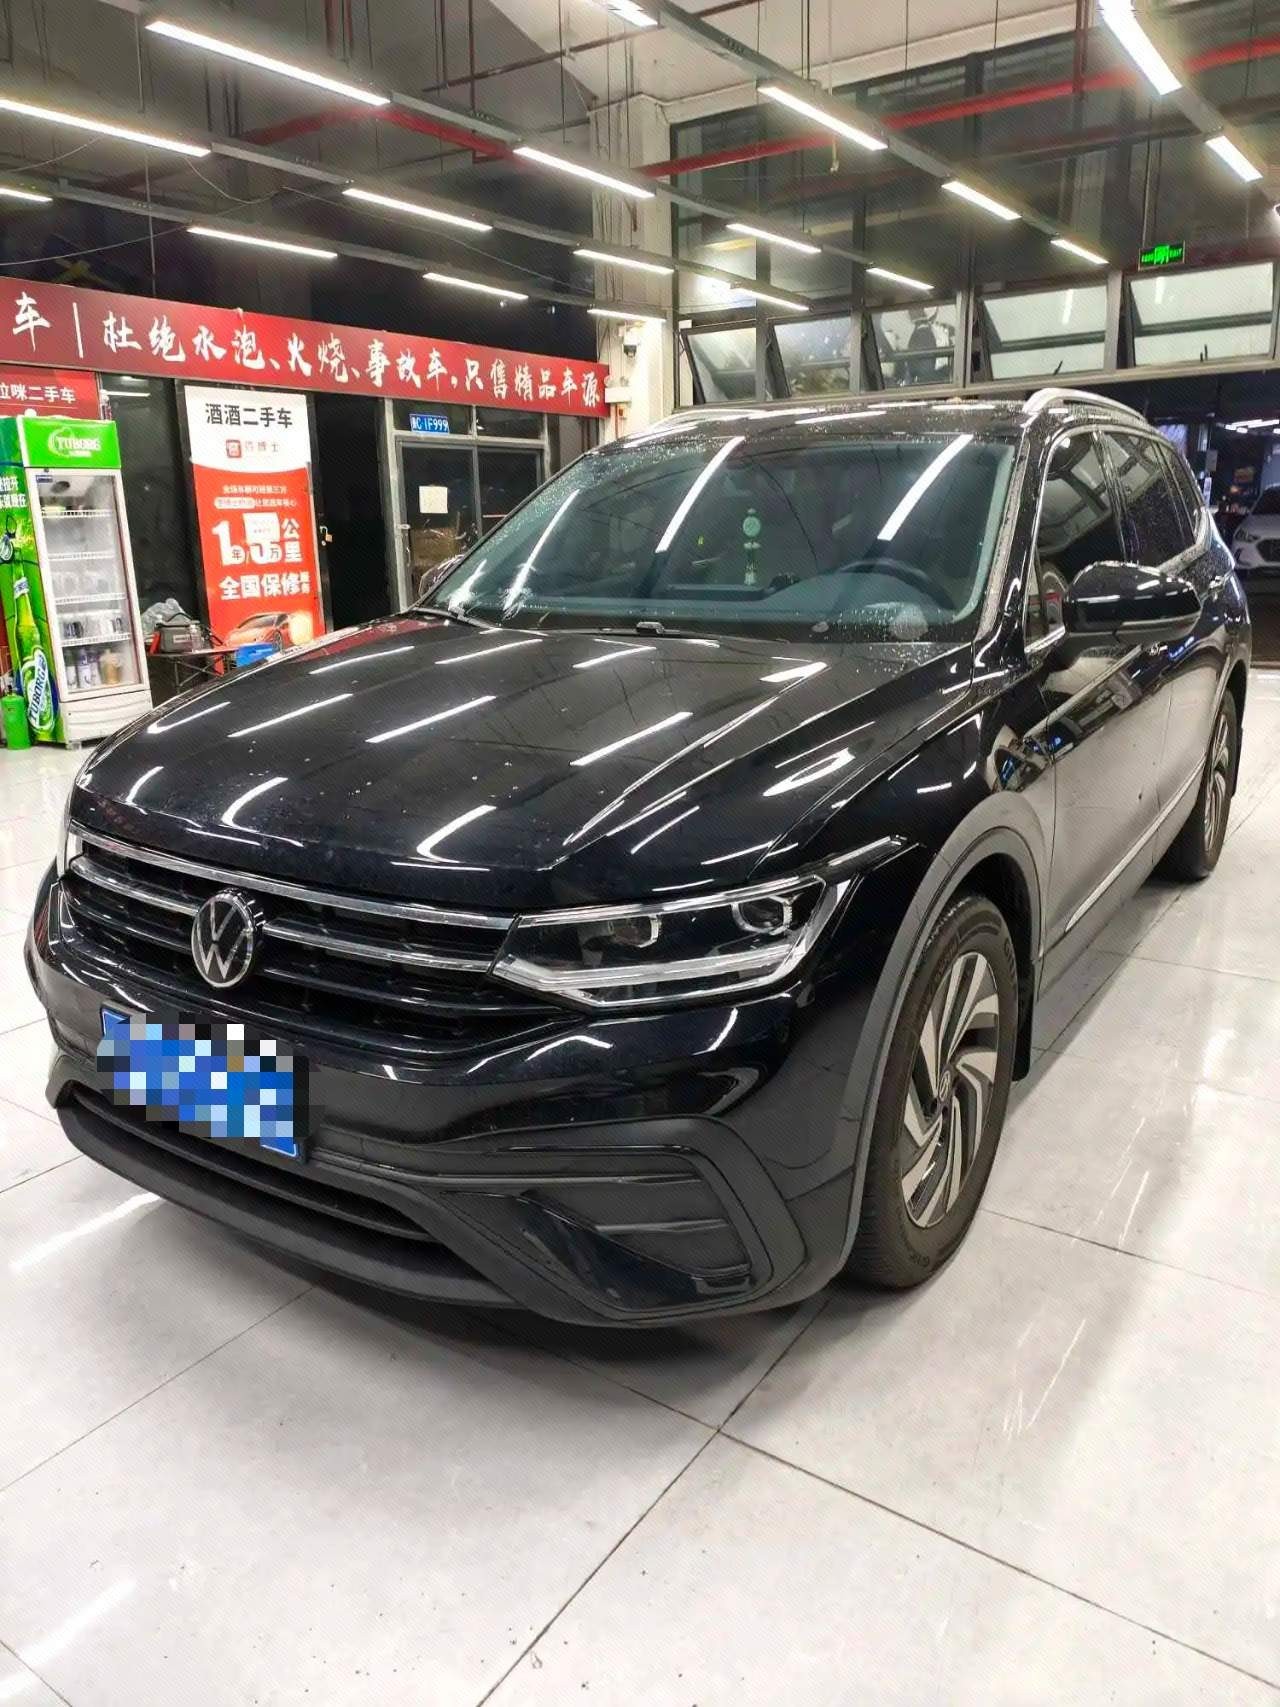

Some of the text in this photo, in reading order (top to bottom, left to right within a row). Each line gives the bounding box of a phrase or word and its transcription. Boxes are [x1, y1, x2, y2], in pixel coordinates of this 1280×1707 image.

[205, 403, 293, 428] 酒酒二手车
